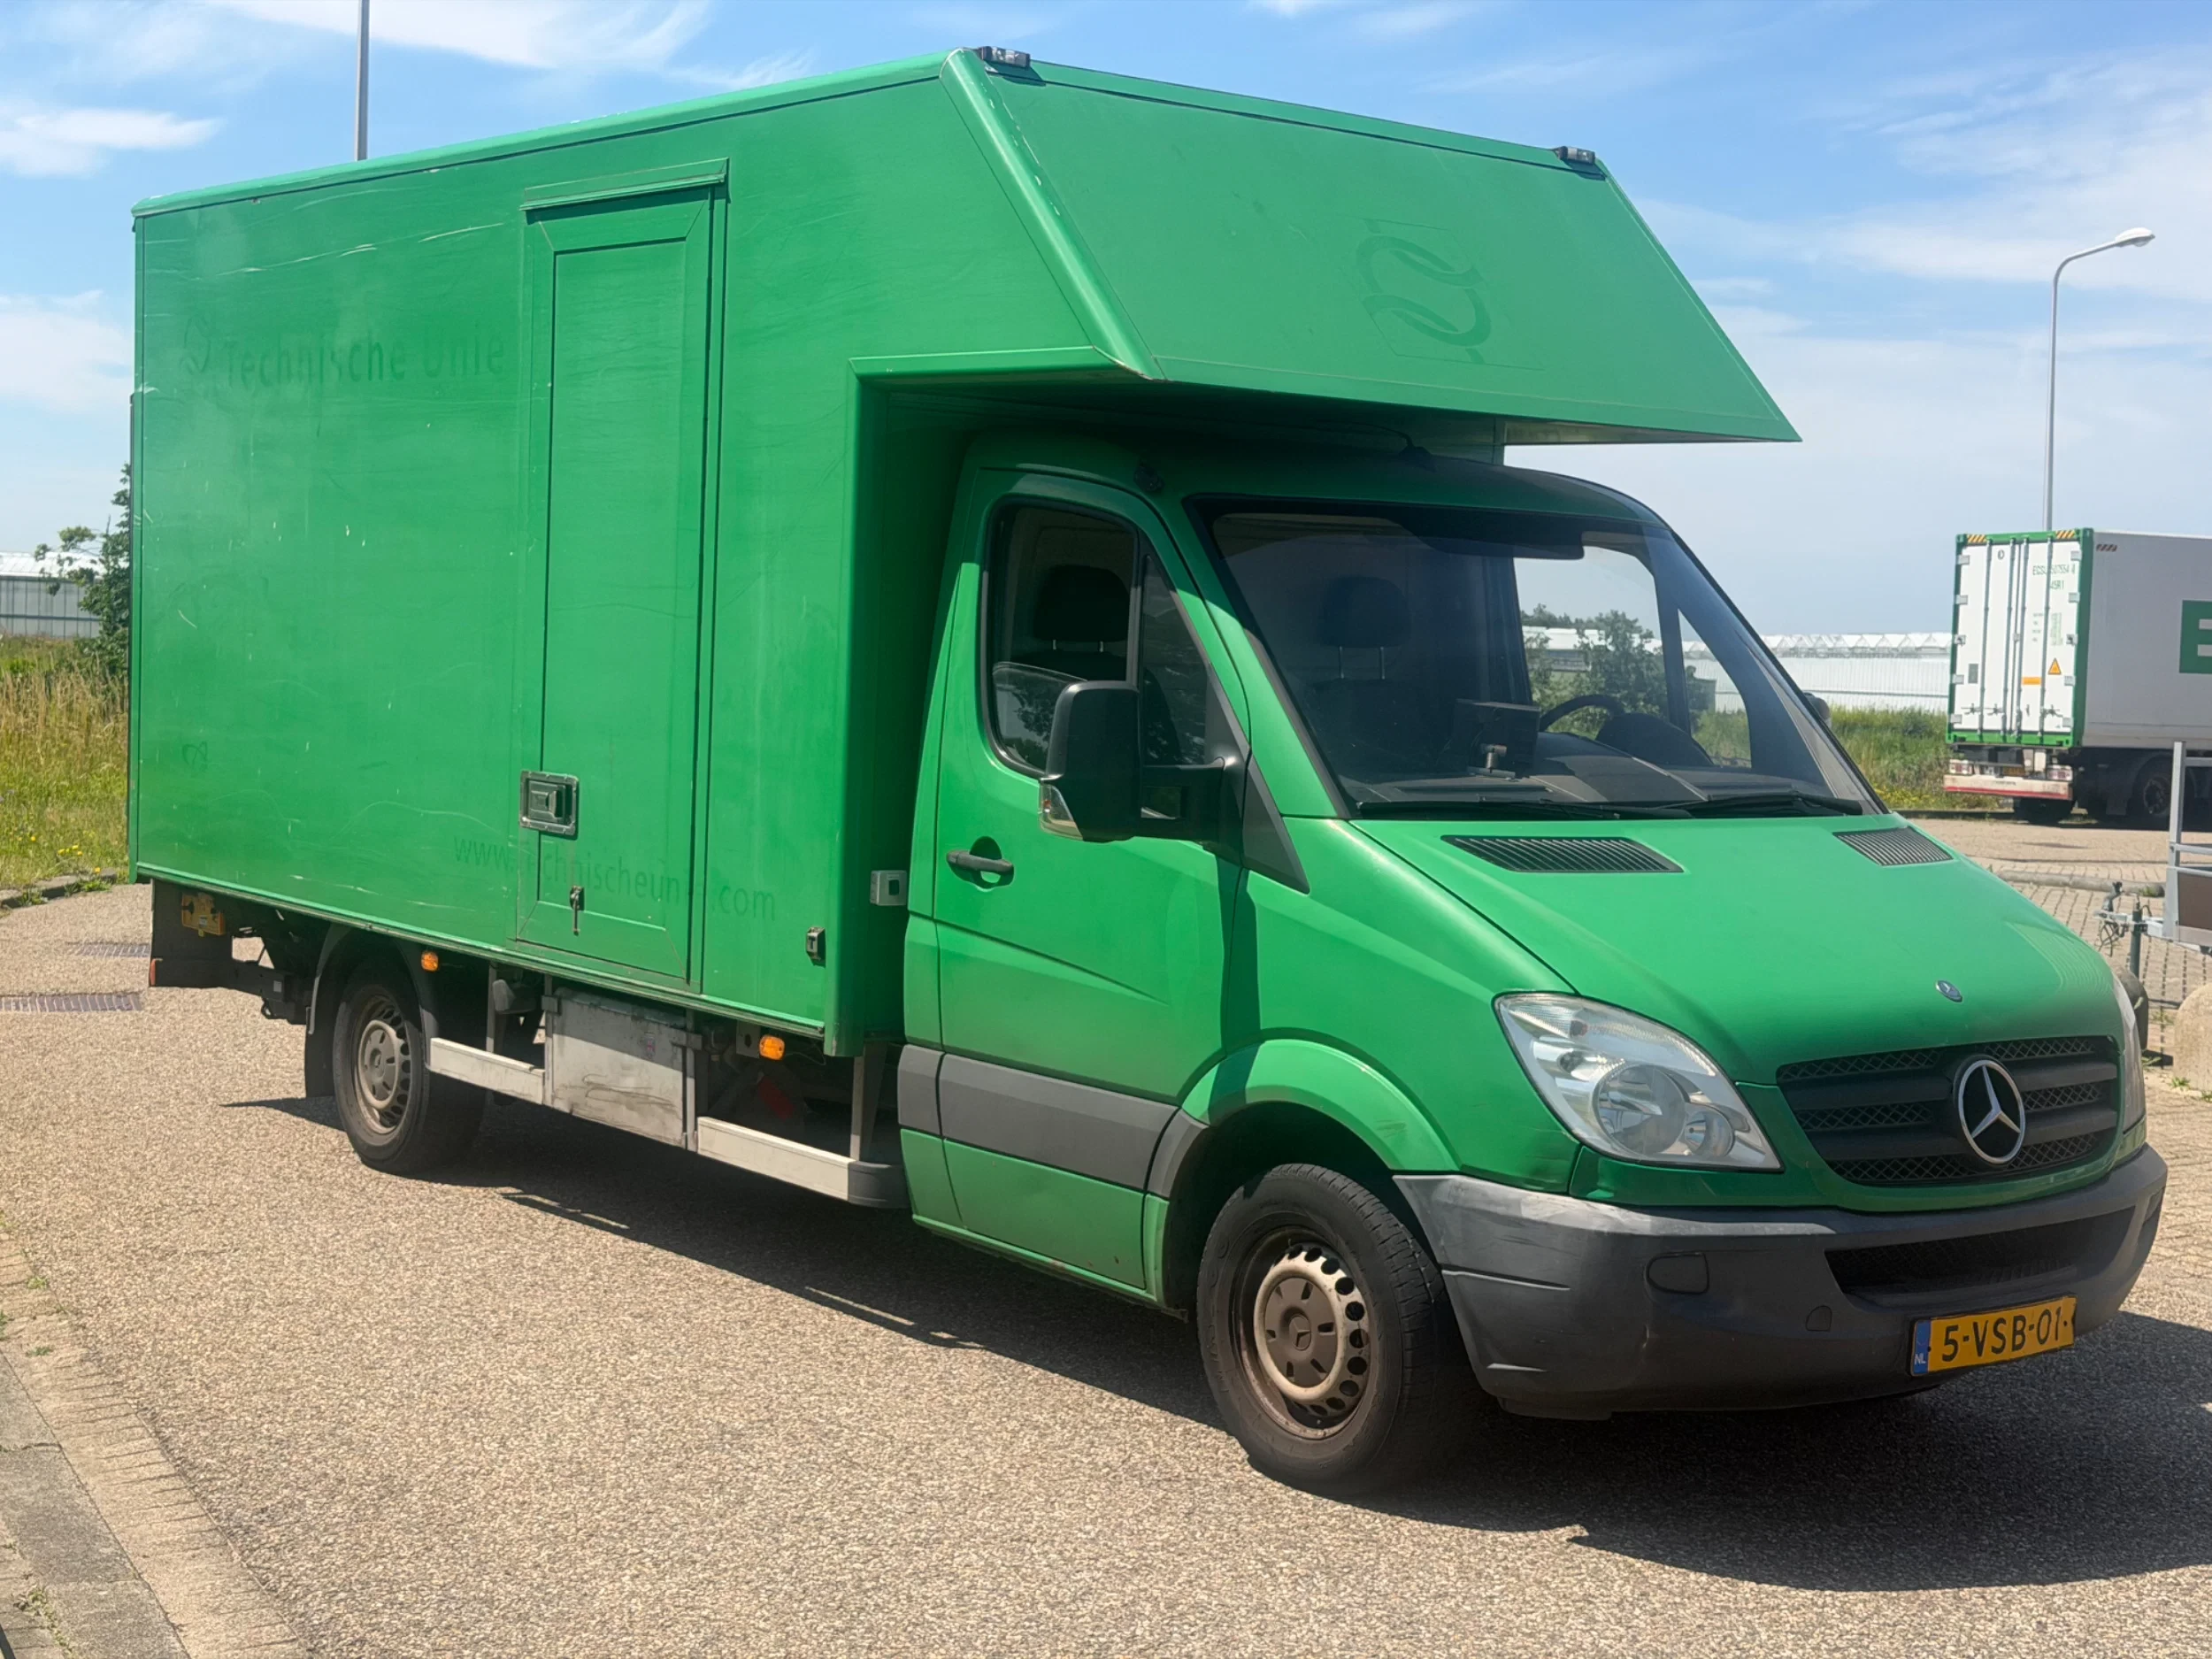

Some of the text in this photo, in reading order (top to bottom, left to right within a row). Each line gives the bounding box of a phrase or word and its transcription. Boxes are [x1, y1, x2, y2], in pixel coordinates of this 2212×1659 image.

[223, 321, 504, 389] Technische Unie
[453, 835, 777, 922] www.chnischeun.com
[1914, 1307, 2062, 1365] NL 5-VSB-01
